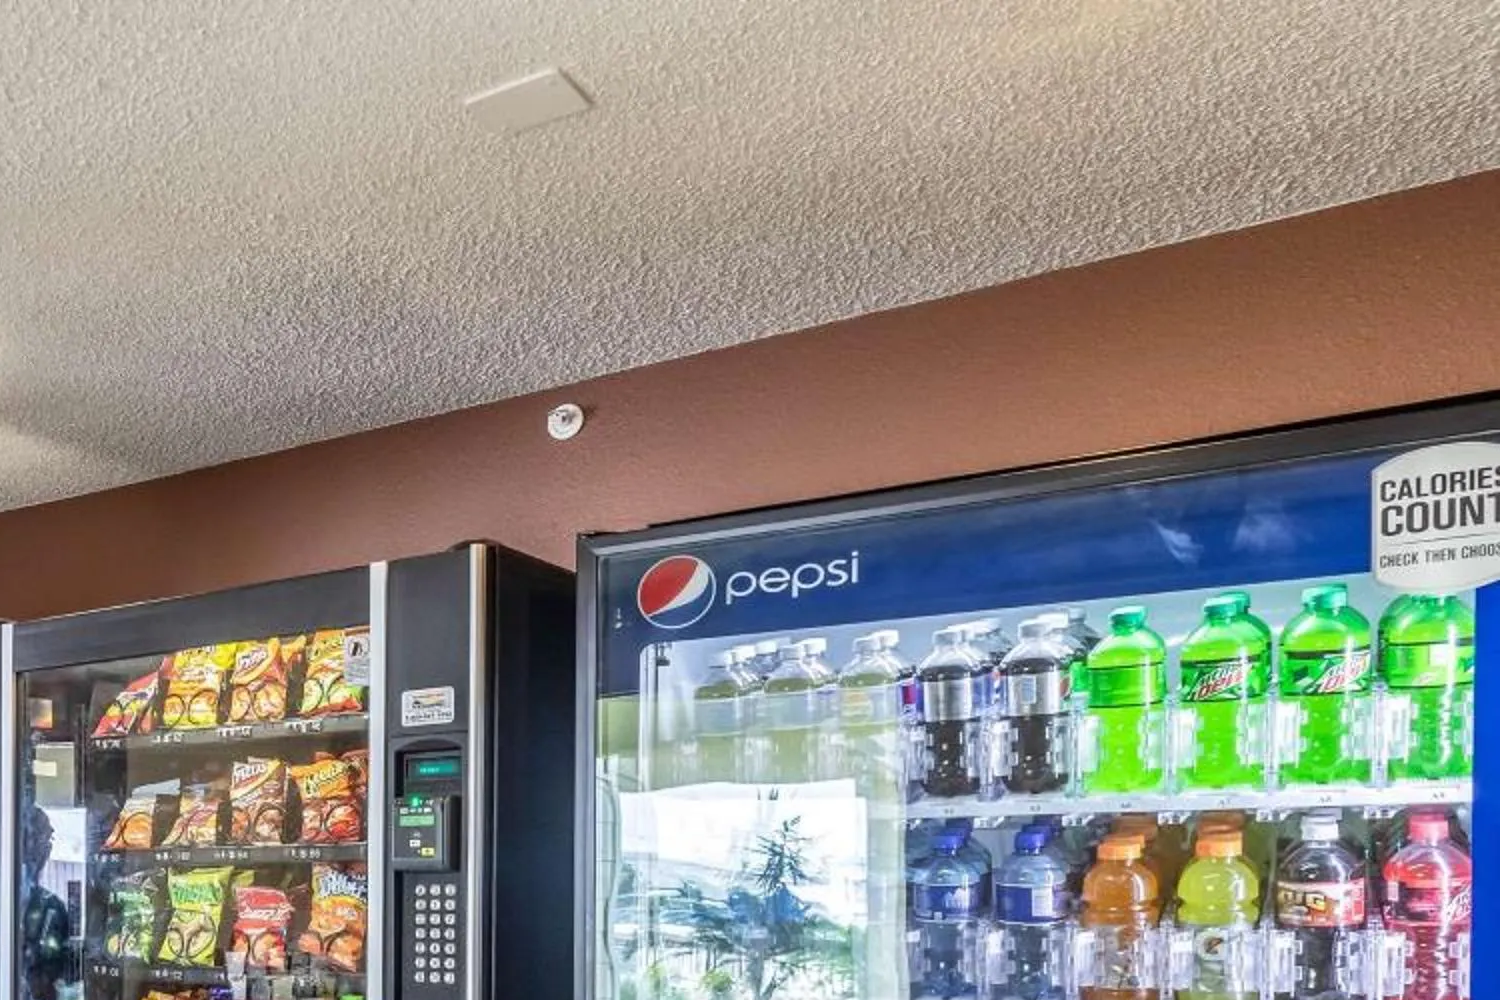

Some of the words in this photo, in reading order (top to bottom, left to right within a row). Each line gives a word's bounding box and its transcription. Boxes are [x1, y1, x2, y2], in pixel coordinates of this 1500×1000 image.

[1379, 551, 1419, 569] CHECK
[1425, 547, 1457, 563] THEN
[725, 550, 859, 605] pepsi
